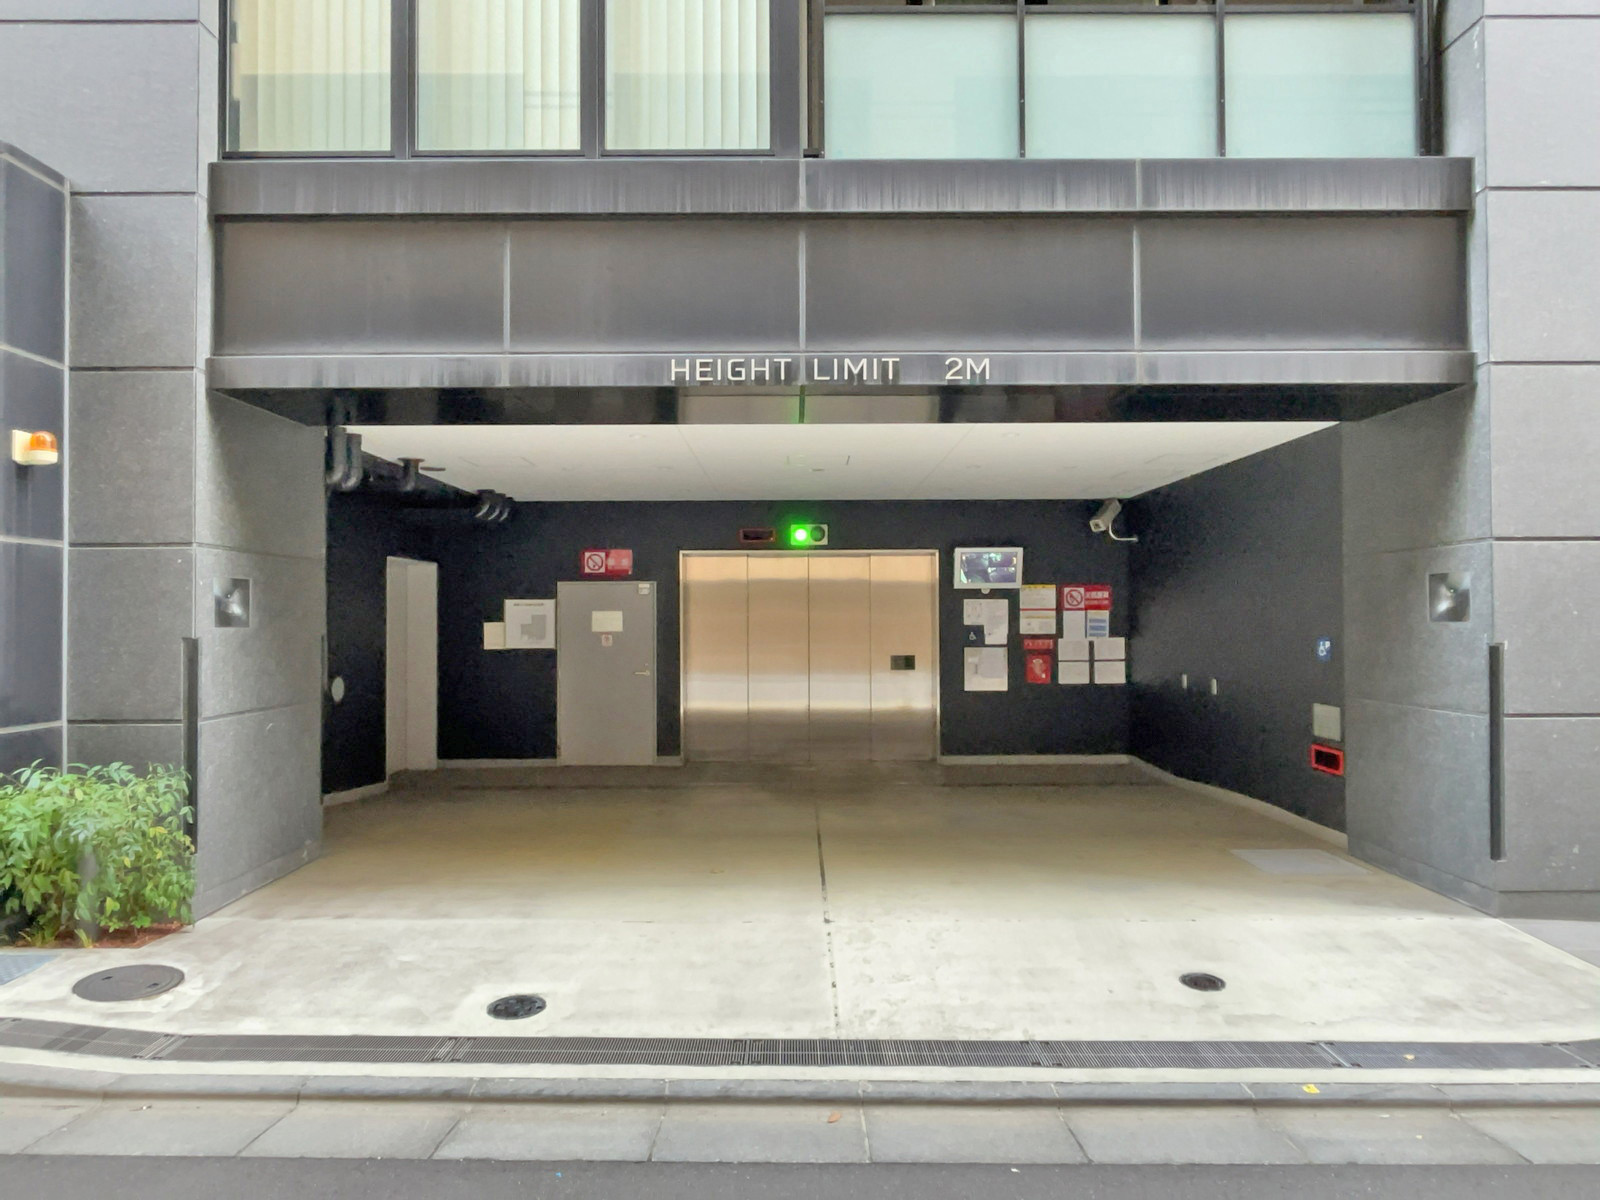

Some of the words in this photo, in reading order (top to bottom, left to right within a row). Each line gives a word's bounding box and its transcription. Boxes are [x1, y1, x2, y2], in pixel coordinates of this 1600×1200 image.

[670, 358, 792, 381] HEIGHT
[813, 357, 900, 381] LIMIT
[945, 357, 990, 380] 2M
